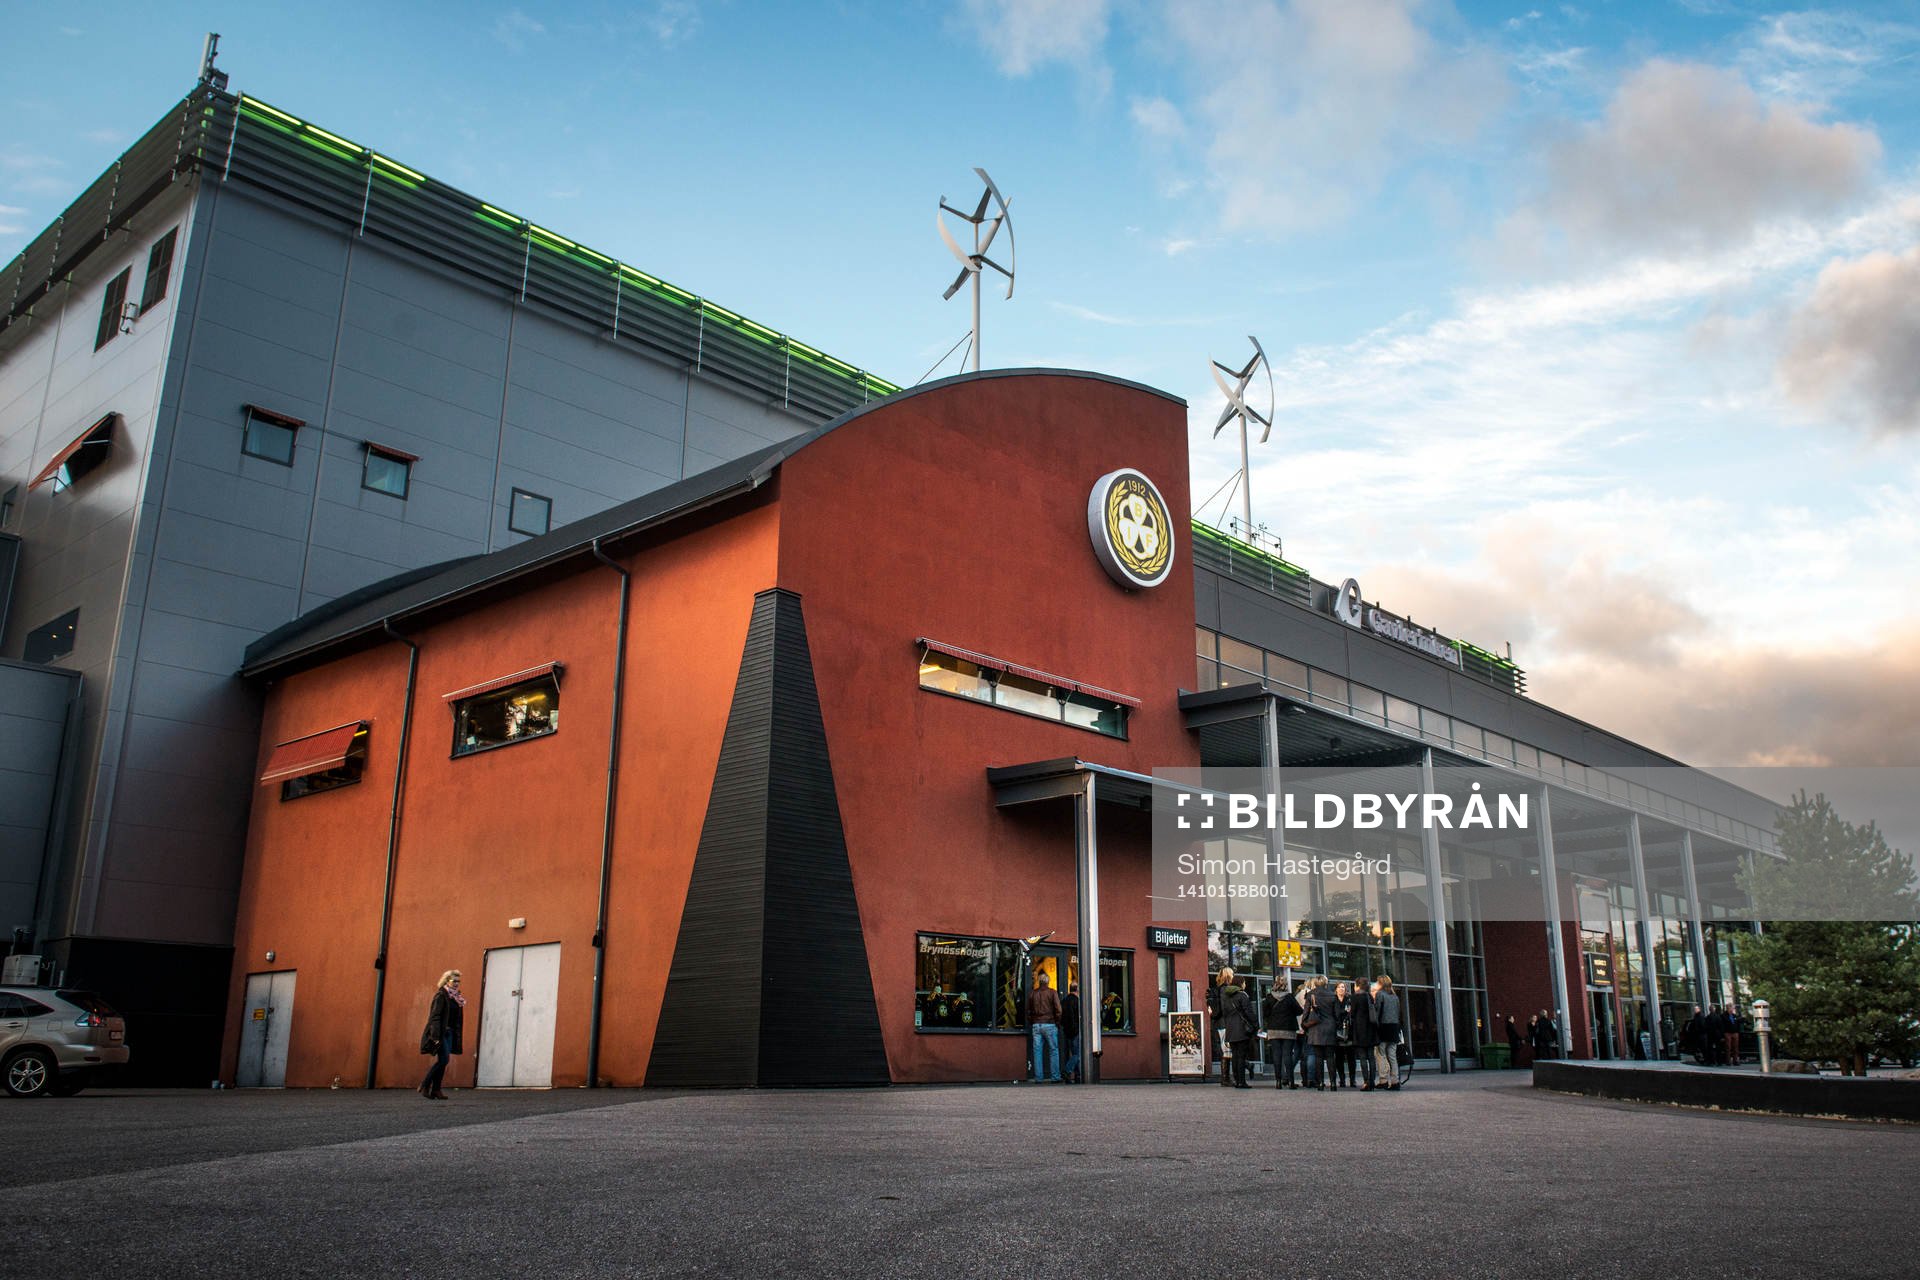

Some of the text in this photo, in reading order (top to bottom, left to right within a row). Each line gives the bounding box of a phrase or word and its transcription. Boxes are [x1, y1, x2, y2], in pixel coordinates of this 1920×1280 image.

[1128, 480, 1146, 496] 1912
[1135, 502, 1143, 518] B
[1155, 930, 1188, 947] Biljetter
[1070, 955, 1128, 967] Bshopen
